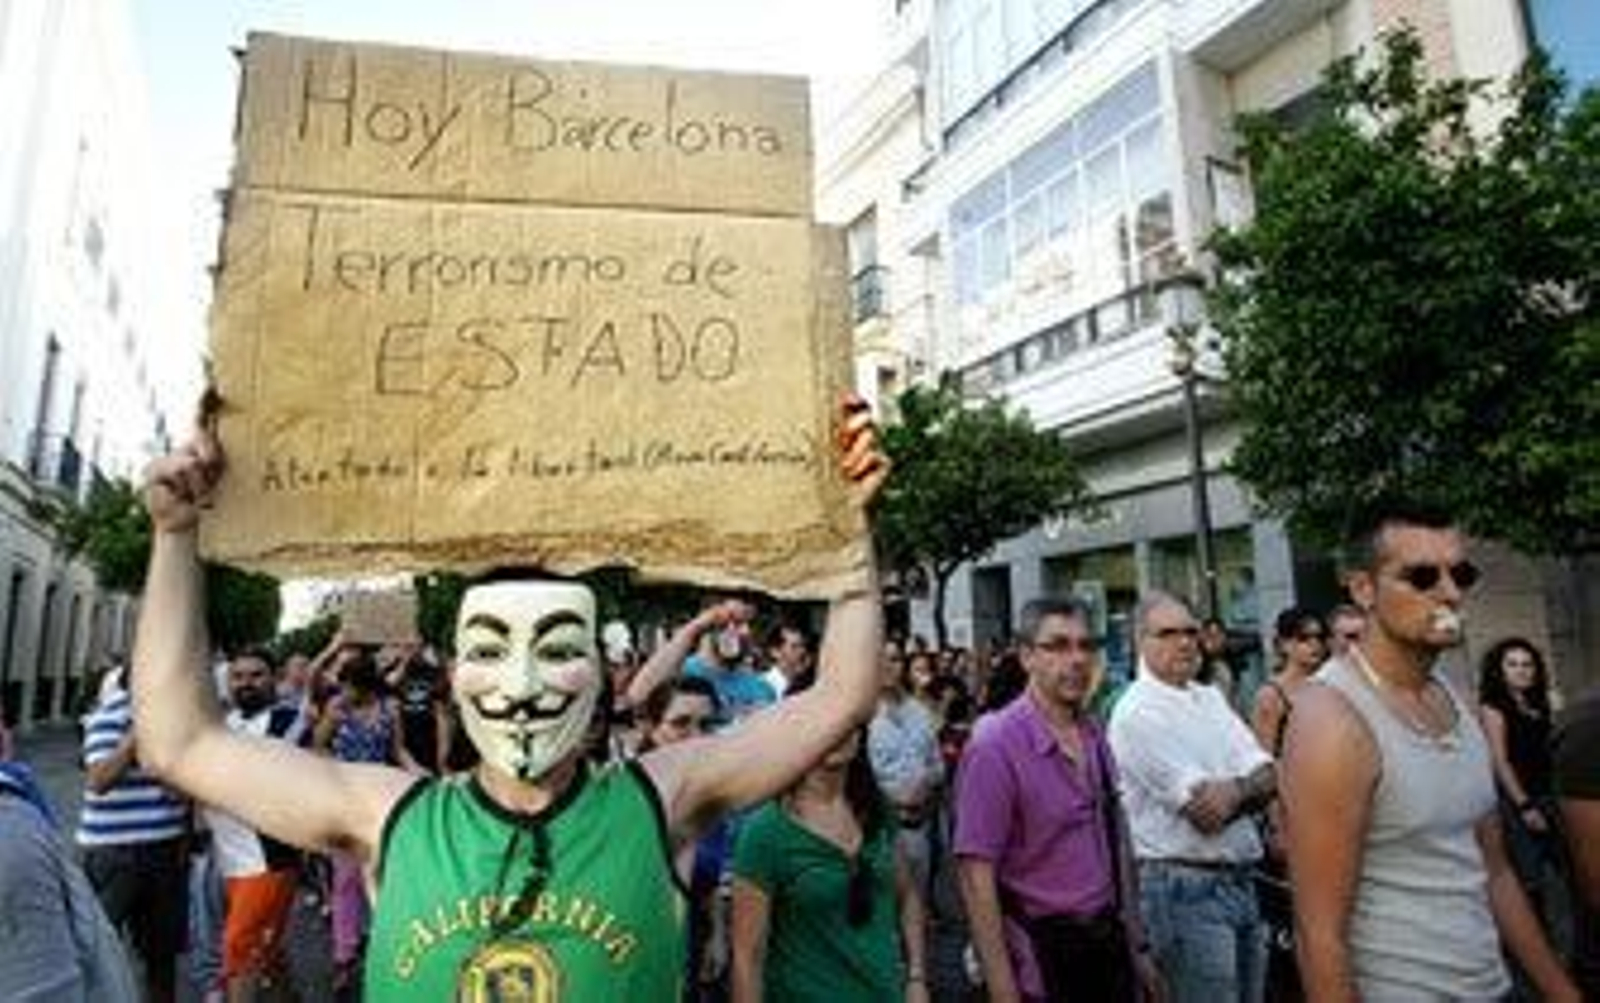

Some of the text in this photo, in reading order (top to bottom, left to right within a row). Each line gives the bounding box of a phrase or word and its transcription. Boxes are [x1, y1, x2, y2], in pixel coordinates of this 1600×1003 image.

[296, 49, 783, 170] Hoy Barcelona
[284, 204, 738, 297] Terrorismo de
[374, 312, 741, 398] ESTADO
